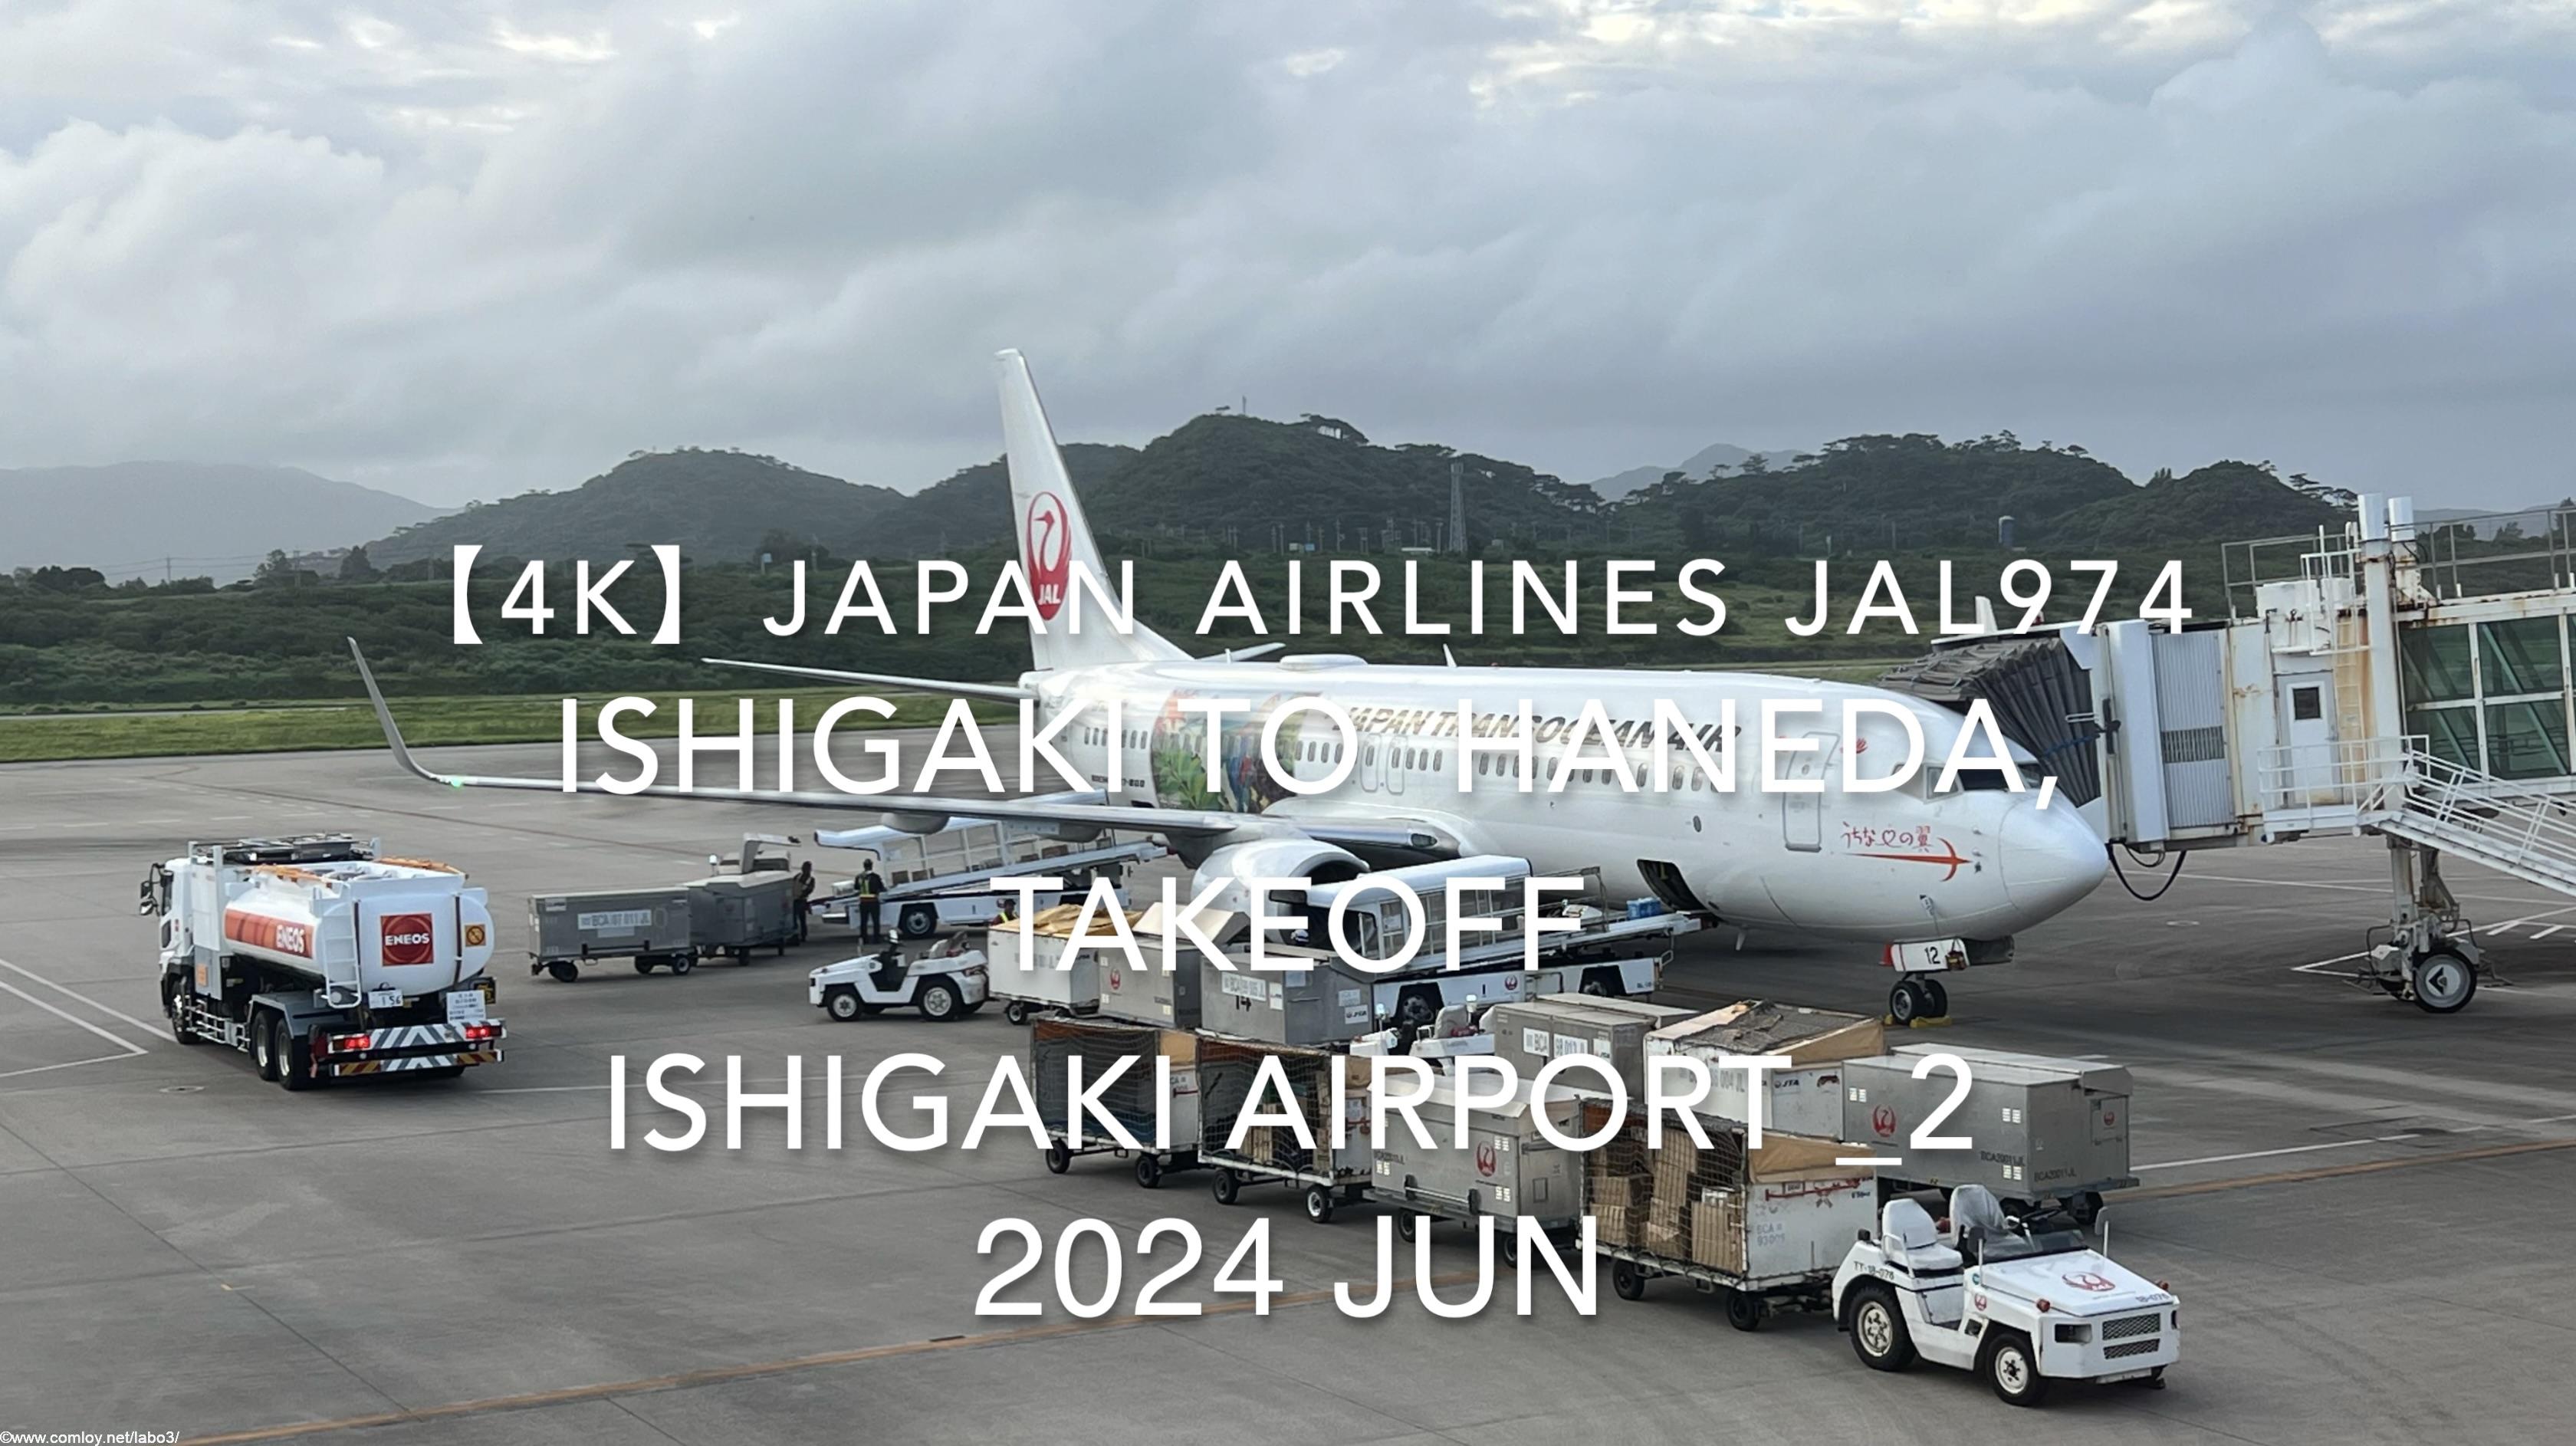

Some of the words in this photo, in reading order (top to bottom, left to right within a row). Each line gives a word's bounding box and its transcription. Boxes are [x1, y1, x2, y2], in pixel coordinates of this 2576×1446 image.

[1038, 583, 1062, 605] JAL
[277, 925, 304, 953] ENEOS
[385, 933, 430, 945] ENEOS
[1924, 946, 1940, 964] 12
